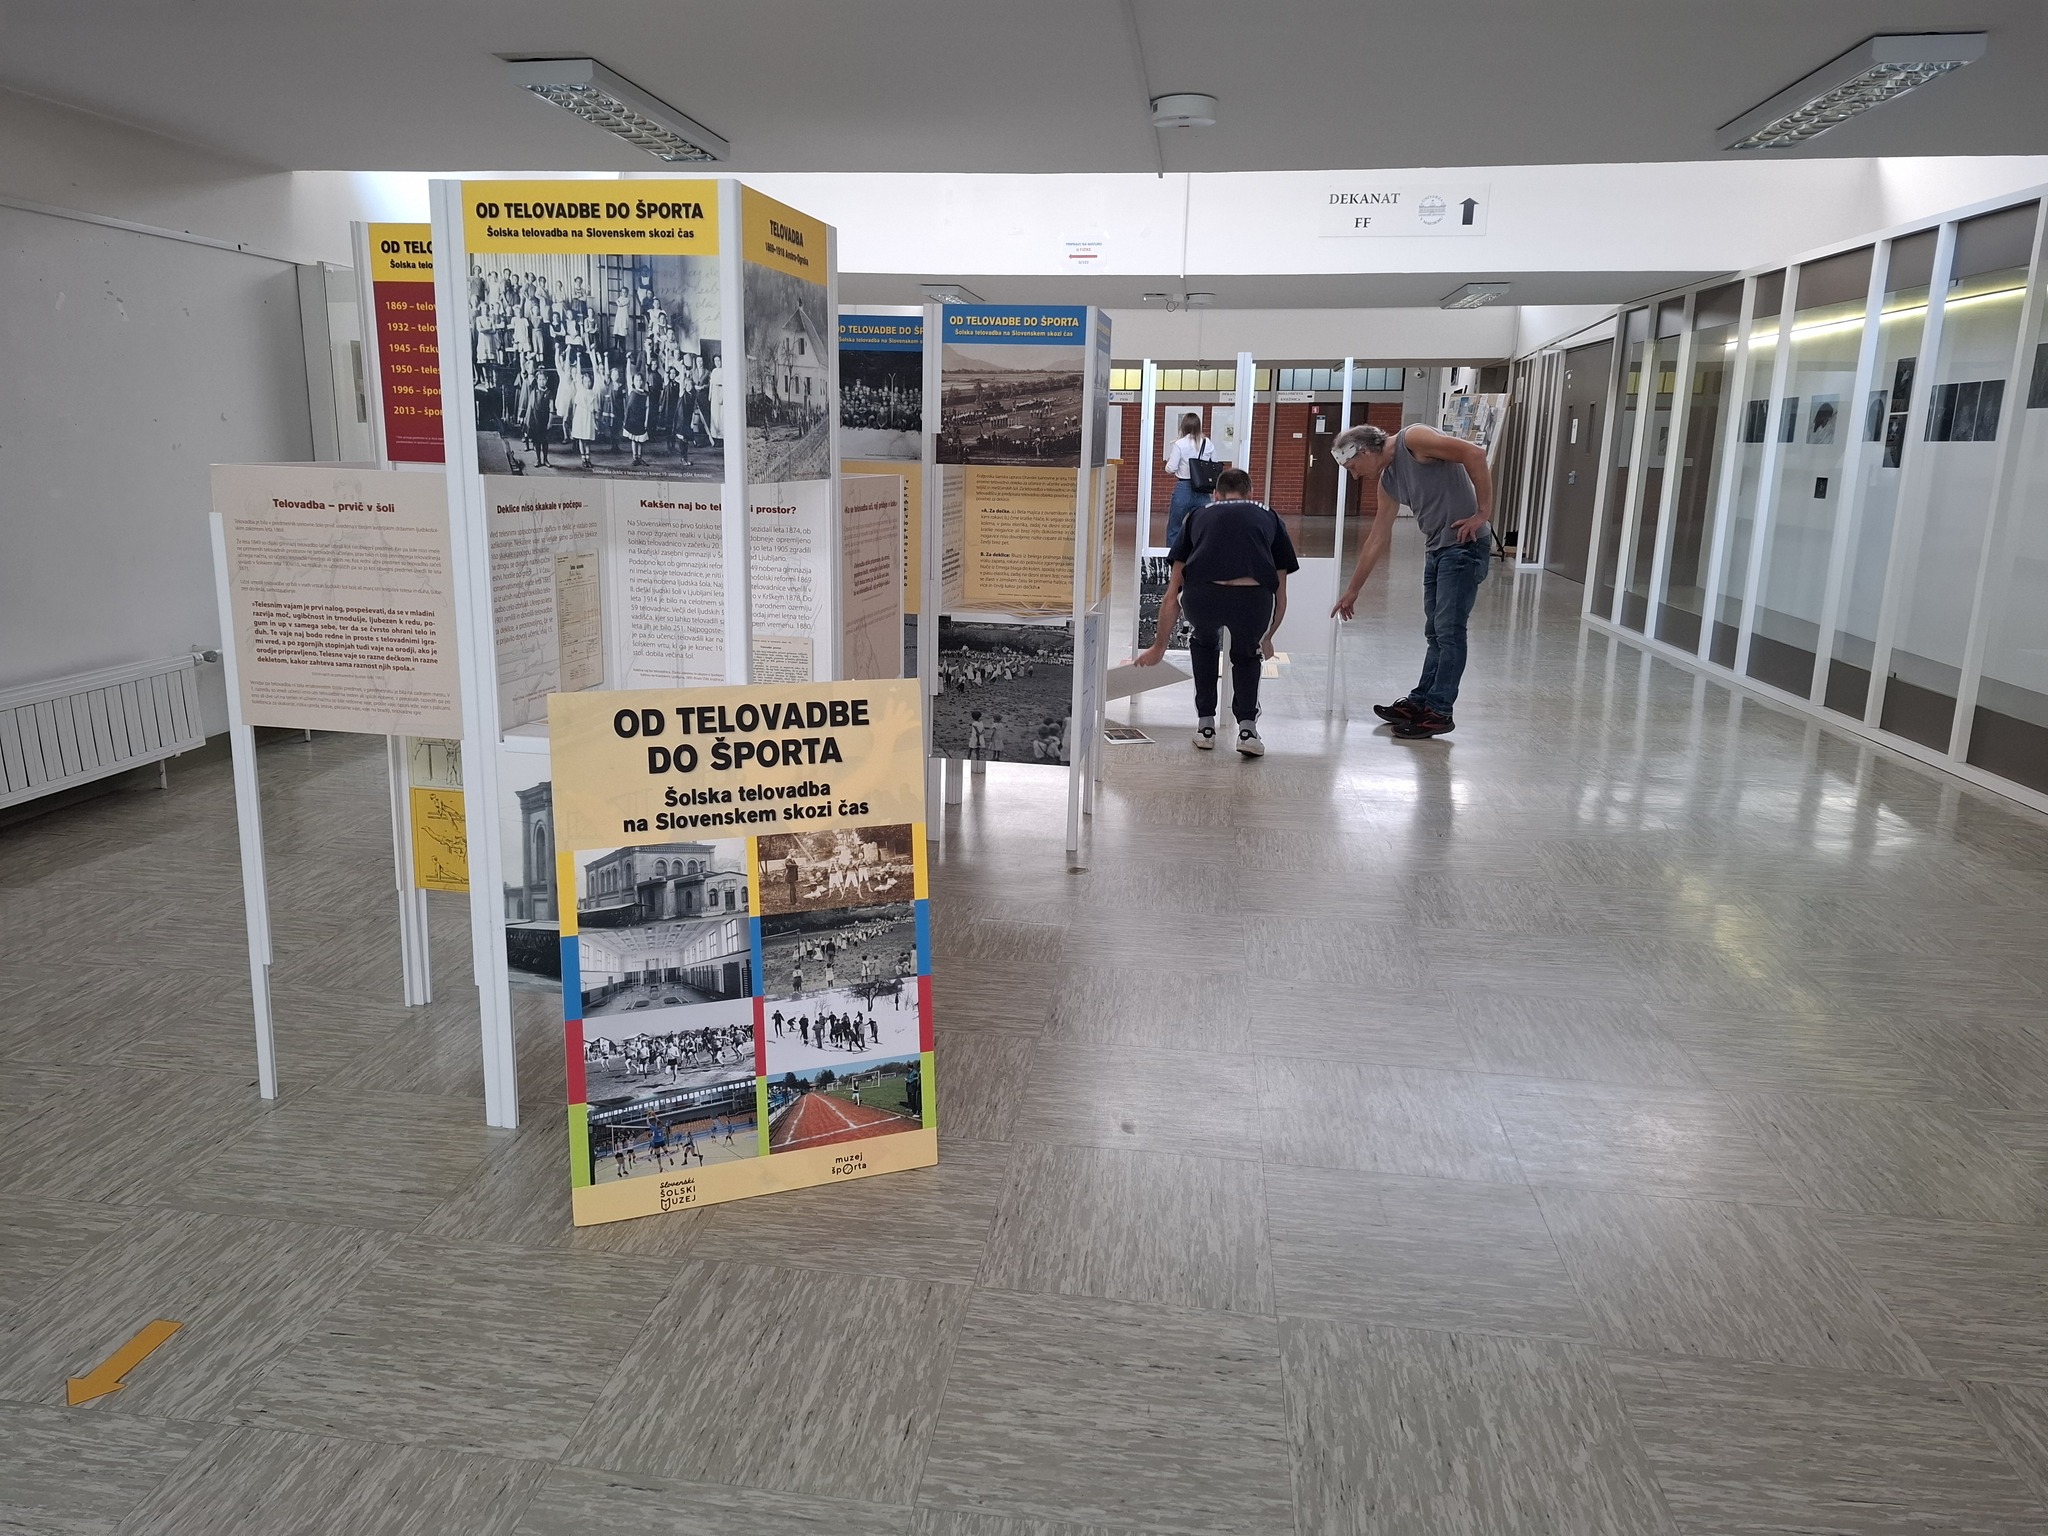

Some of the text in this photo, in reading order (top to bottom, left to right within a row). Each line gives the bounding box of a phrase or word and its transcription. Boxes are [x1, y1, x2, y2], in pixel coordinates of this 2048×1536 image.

[1329, 193, 1400, 205] DEKANAT
[475, 199, 704, 219] OD TELOVADBE DO ŠPORTA
[1354, 217, 1371, 228] FF
[487, 225, 694, 238] Šolska telovadba na Slovenskem skozi čas
[770, 219, 803, 247] TELOVADBA
[381, 240, 400, 254] OD
[390, 259, 416, 269] Šolska
[386, 301, 408, 311] 1869
[387, 322, 409, 332] 1932
[949, 315, 1079, 327] OD TELOVADBE DO ŠPORTA
[838, 325, 846, 333] D
[848, 326, 897, 334] TELOVADBE
[389, 343, 411, 353] 1945
[391, 364, 412, 374] 1950
[392, 385, 414, 394] 1996
[394, 406, 415, 415] 2013
[272, 499, 325, 510] Telovadba
[338, 502, 364, 513] prvič
[376, 503, 395, 513] šoli
[497, 504, 519, 514] Deklice
[521, 503, 533, 512] niso
[535, 502, 557, 511] skakale
[563, 500, 582, 510] počepu
[640, 499, 675, 509] Kakšen
[678, 502, 692, 511] naj
[695, 502, 706, 510] bo
[756, 506, 797, 514] prostor?
[324, 605, 344, 613] nalog,
[346, 607, 386, 615] pospeševati,
[410, 609, 435, 617] mladini
[275, 611, 291, 619] moč,
[369, 616, 397, 624] ljubezen
[294, 622, 319, 630] samega
[613, 699, 870, 739] OD TELOVADBE
[647, 737, 842, 774] DO ŠPORTA
[664, 781, 831, 807] Šolska telovadba
[624, 799, 870, 832] na Slovenskem skozi čas
[836, 1152, 863, 1164] muzej
[660, 1186, 695, 1198] ŠOLSKI
